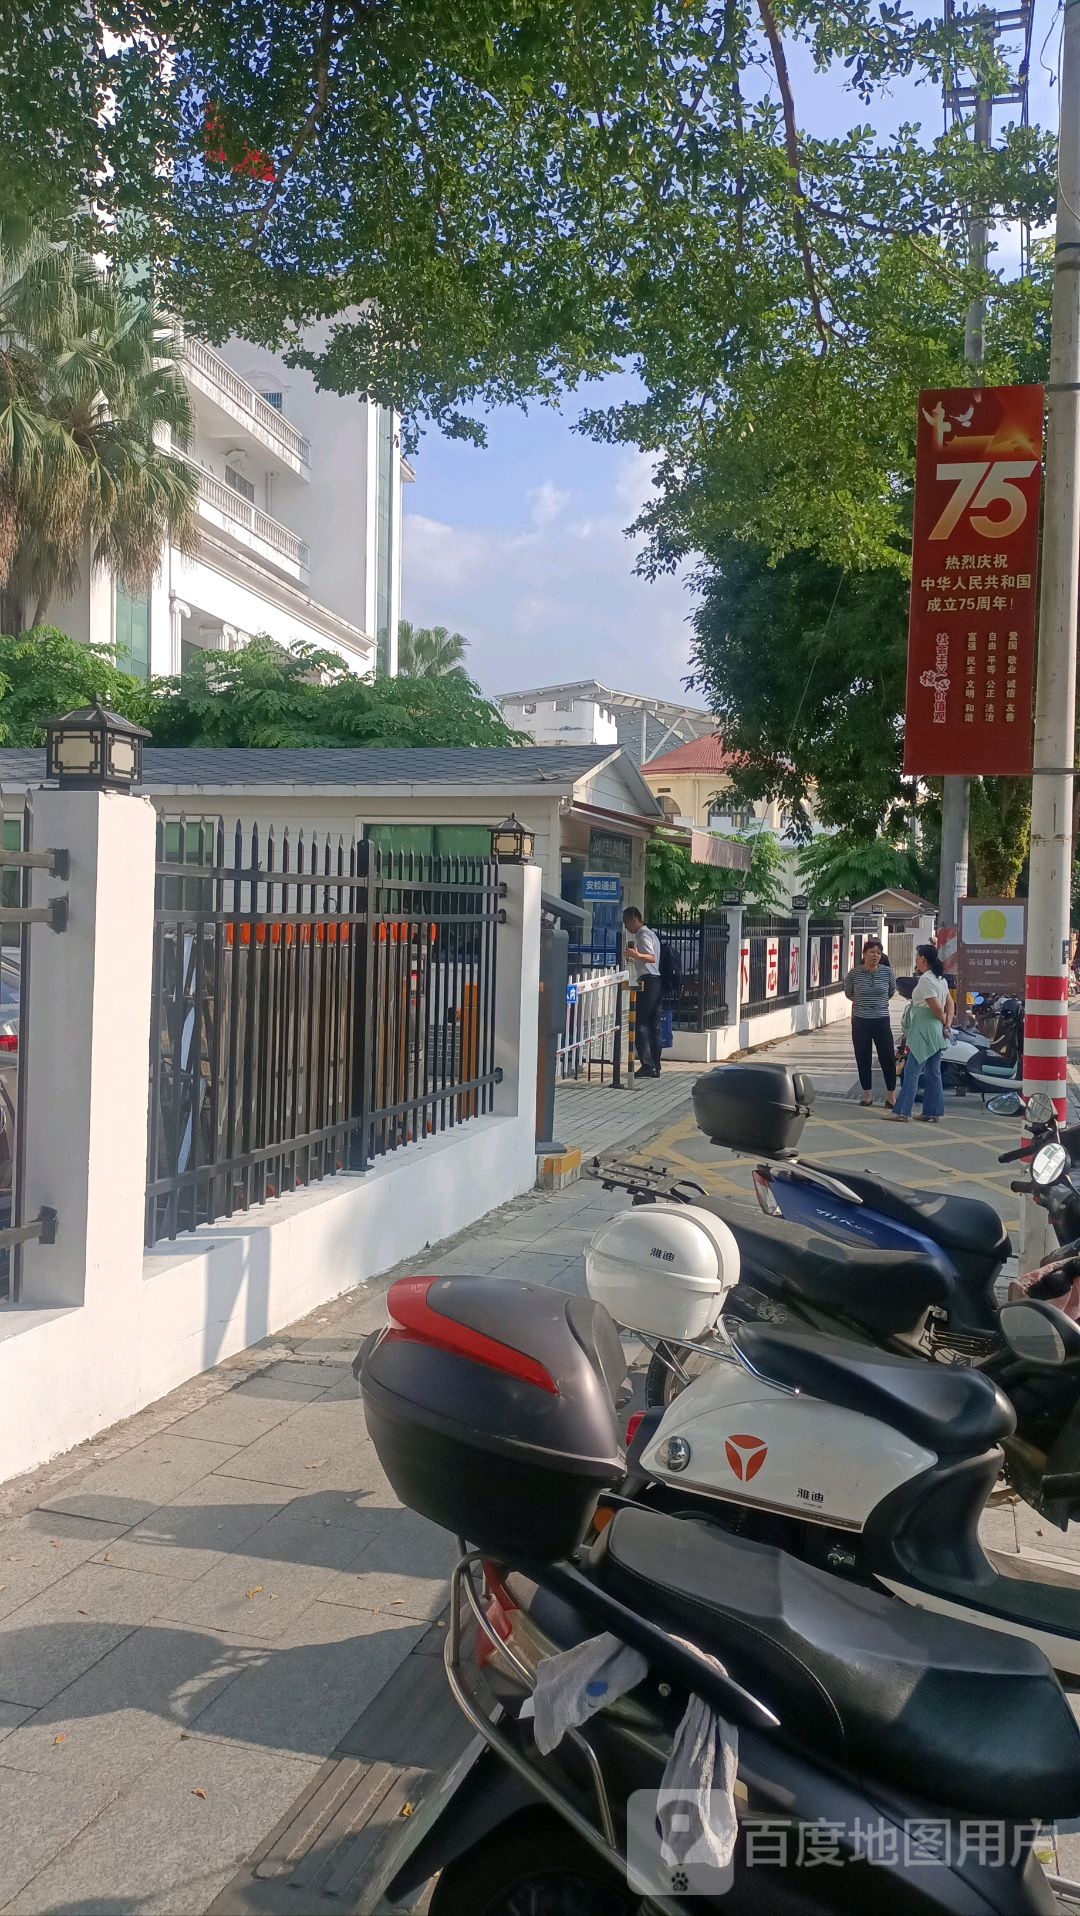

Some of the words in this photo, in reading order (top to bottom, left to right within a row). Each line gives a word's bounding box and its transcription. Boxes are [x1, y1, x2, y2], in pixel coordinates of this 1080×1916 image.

[928, 461, 1039, 541] 75
[945, 554, 1008, 570] 热烈庆祝
[921, 574, 1031, 592] 中华人民共和国
[967, 632, 977, 651] 富强
[988, 632, 997, 650] 自由
[1008, 631, 1018, 650] 爱国
[966, 656, 976, 675] 民主
[986, 656, 996, 674] 平等
[1007, 655, 1017, 674] 敬业
[920, 633, 950, 724] 社会主义核心价值观
[965, 680, 975, 699] 文明
[985, 680, 995, 698] 公正
[1006, 680, 1017, 698] 诚信
[964, 704, 974, 722] 和谐
[984, 704, 994, 722] 法治
[1005, 703, 1015, 722] 友善
[586, 880, 617, 891] 安检通道
[649, 1247, 675, 1263] 雅迪
[796, 1488, 825, 1504] 雅迪
